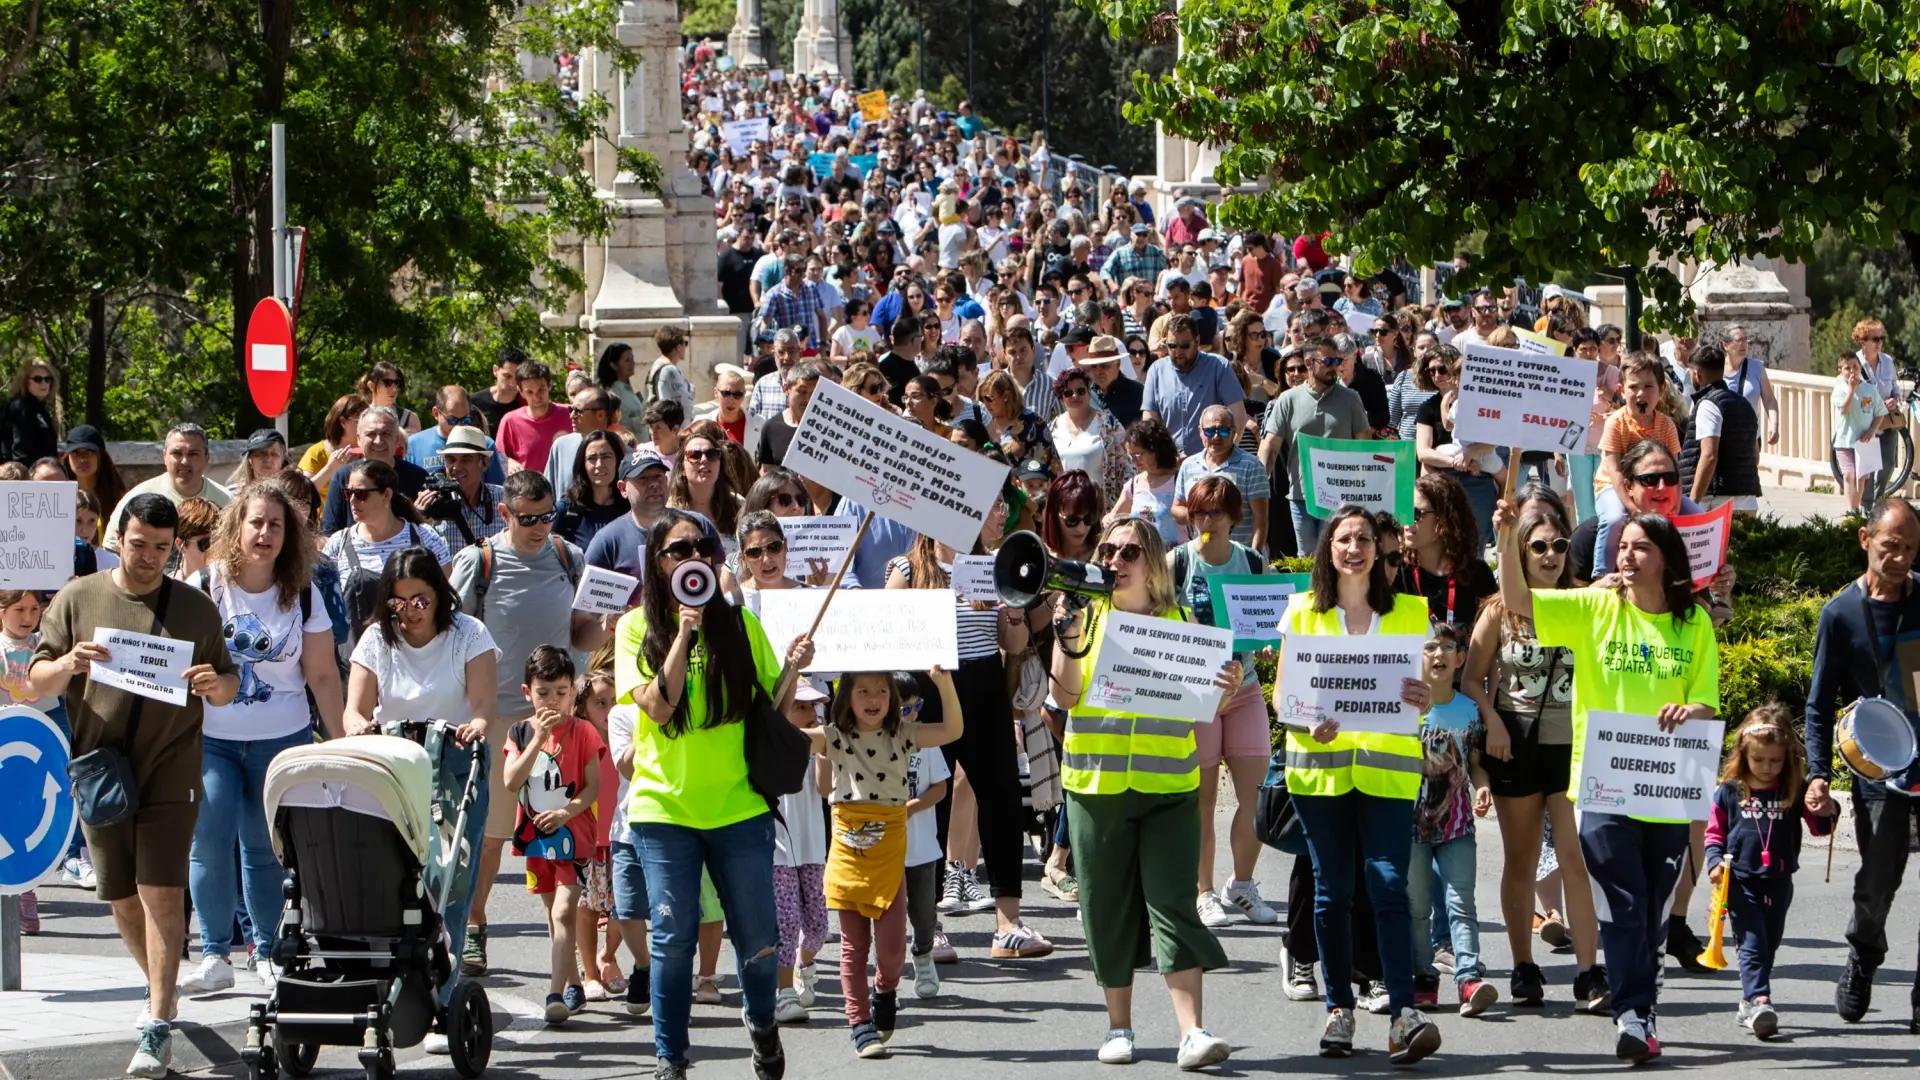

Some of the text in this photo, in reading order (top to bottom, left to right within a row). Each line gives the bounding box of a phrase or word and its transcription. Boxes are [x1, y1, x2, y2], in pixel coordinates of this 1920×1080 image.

[1467, 354, 1499, 365] Somos
[1466, 364, 1514, 377] tratarnos
[1518, 372, 1544, 381] como
[1561, 378, 1585, 388] debe
[1472, 375, 1525, 388] PEDIATRA
[1528, 383, 1541, 391] YA
[1560, 388, 1585, 397] Mora
[1478, 386, 1522, 398] Rubielos
[1478, 408, 1568, 428] SIN SALUD
[818, 392, 955, 463] La salud es la mejor
[812, 404, 961, 481] herencia que podemos
[797, 441, 828, 464] YA!!!
[807, 418, 843, 440] dejar
[846, 439, 854, 448] a
[860, 443, 880, 460] los
[884, 456, 925, 481] niños,
[931, 477, 965, 498] Mora
[1327, 463, 1359, 471] QUEREMOS
[801, 430, 817, 443] de
[820, 440, 879, 474] Rubielos
[883, 470, 906, 487] con
[910, 482, 982, 521] PEDIATRA
[1326, 477, 1365, 487] QUEREMOS
[8, 492, 68, 518] REAL
[1341, 494, 1382, 502] PEDIATRAS
[0, 525, 25, 542] ndo
[1691, 539, 1710, 549] TERUEL
[1691, 560, 1712, 571] EDIATRA
[590, 589, 613, 599] QUEREMOS
[596, 601, 621, 611] SOLUCIONES
[1119, 624, 1226, 650] POR UN SERVICIO DE PEDIATRÍA
[122, 638, 140, 647] NIÑOS
[147, 642, 165, 651] NIÑAS
[1133, 647, 1156, 658] DIGNO
[1157, 650, 1162, 659] Y
[1165, 650, 1174, 661] DE
[1297, 652, 1411, 665] NO QUEREMOS TIRITAS,
[1606, 640, 1628, 655] MORA
[1648, 645, 1693, 664] RUBIELOS
[140, 656, 168, 667] TERUEL
[1605, 657, 1652, 675] PEDIATRA
[128, 669, 156, 679] MERECEN
[1113, 664, 1151, 678] LUCHAMOS
[1152, 669, 1167, 680] HOY
[1169, 671, 1183, 682] CON
[1184, 673, 1210, 686] FUERZA
[137, 682, 174, 694] PEDIATRA
[1310, 677, 1377, 690] QUEREMOS
[1135, 687, 1182, 701] SOLIDARIDAD
[1334, 700, 1401, 714] PEDIATRAS
[1598, 730, 1710, 751] NO QUEREMOS TIRITAS,
[1611, 756, 1676, 775] QUEREMOS
[1633, 783, 1702, 800] SOLUCIONES
